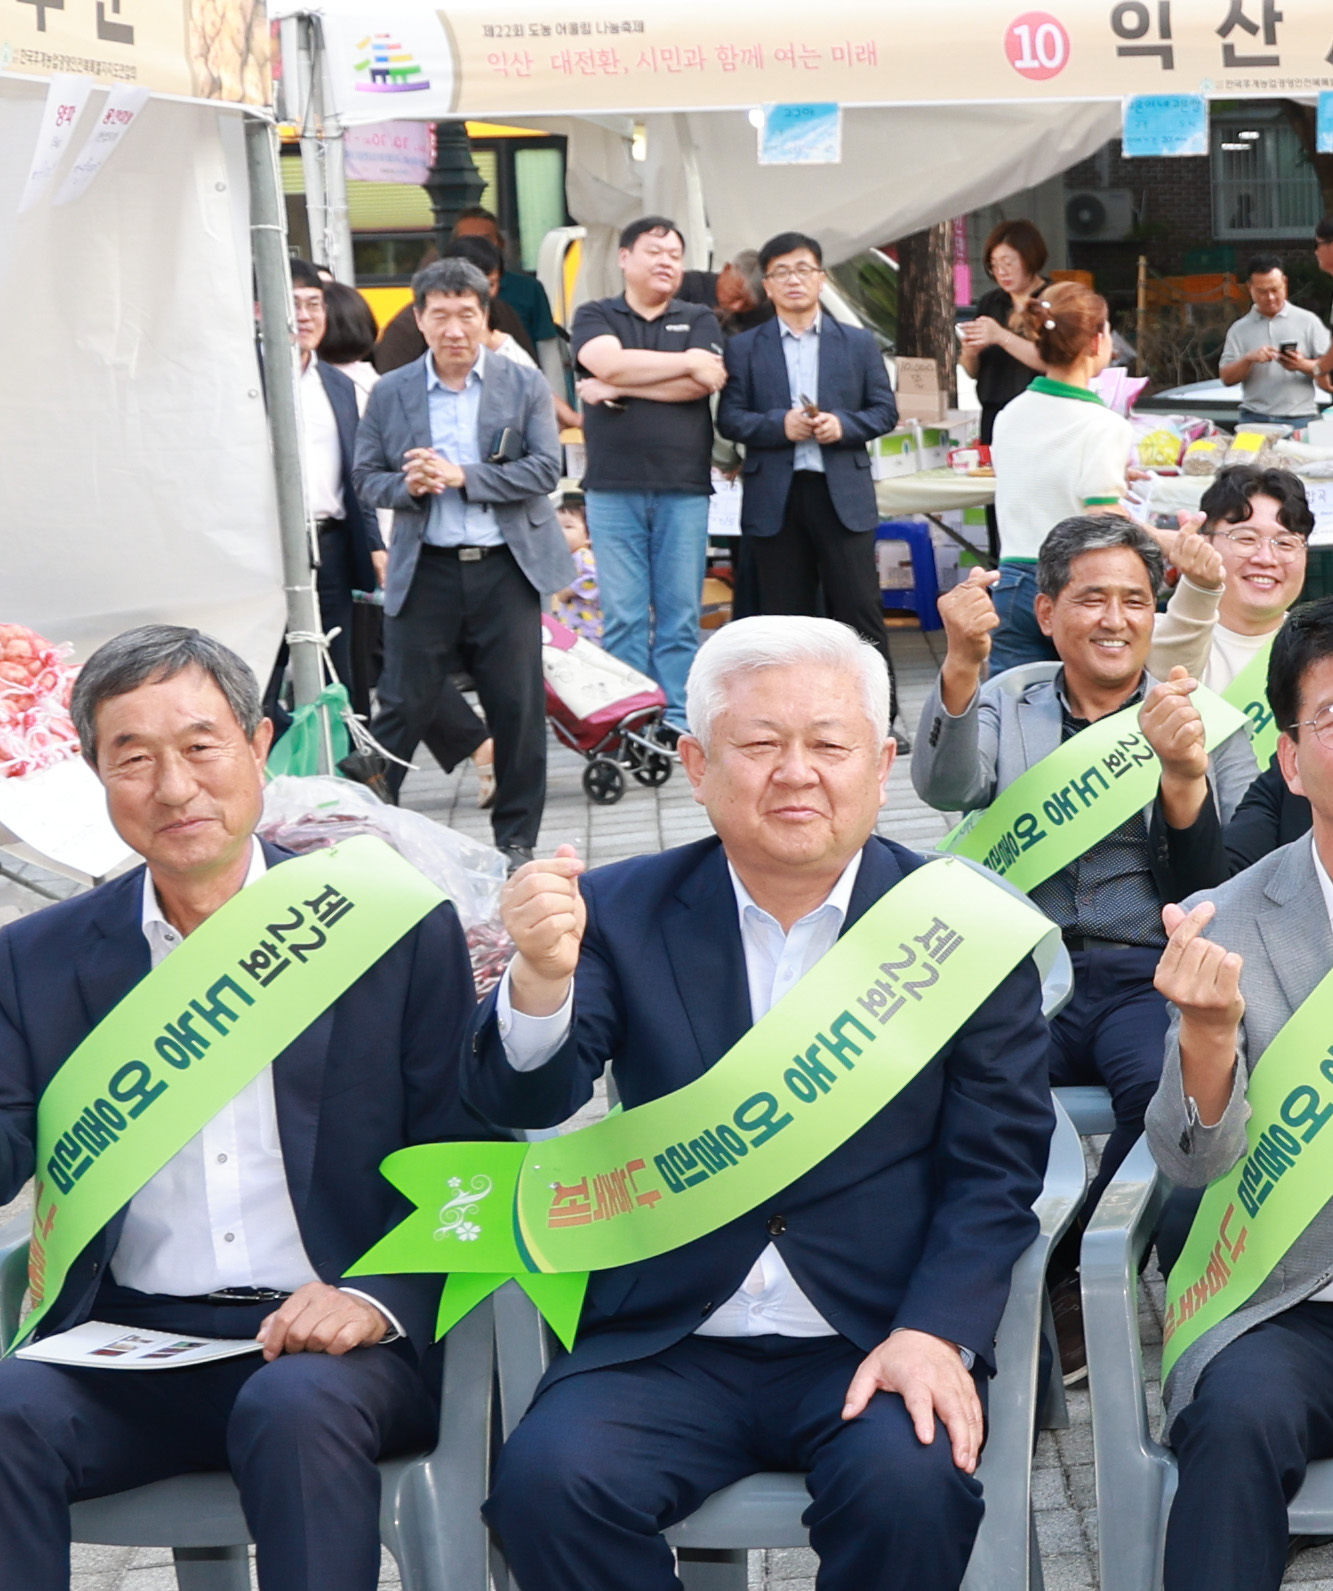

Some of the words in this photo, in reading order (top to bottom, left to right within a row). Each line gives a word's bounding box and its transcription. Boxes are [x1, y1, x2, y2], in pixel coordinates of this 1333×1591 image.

[482, 22, 525, 38] 제22회
[528, 22, 551, 37] 도농
[555, 21, 592, 37] 어울림
[596, 20, 645, 34] 나눔축제
[487, 49, 534, 78] 익산
[550, 47, 631, 76] 대전환,
[636, 46, 707, 73] 시민과
[716, 43, 764, 72] 함께
[774, 42, 822, 70] 여는
[832, 40, 878, 68] 미래
[1012, 23, 1065, 69] 10
[1042, 766, 1111, 826] 도농
[239, 884, 355, 988] 제22회
[856, 915, 965, 1026] 제22회
[154, 973, 256, 1071] 도농
[782, 1009, 877, 1104] 도농
[48, 1059, 169, 1196] 어울림
[661, 1091, 794, 1196] 어울림
[546, 1157, 663, 1230] 나눔축제
